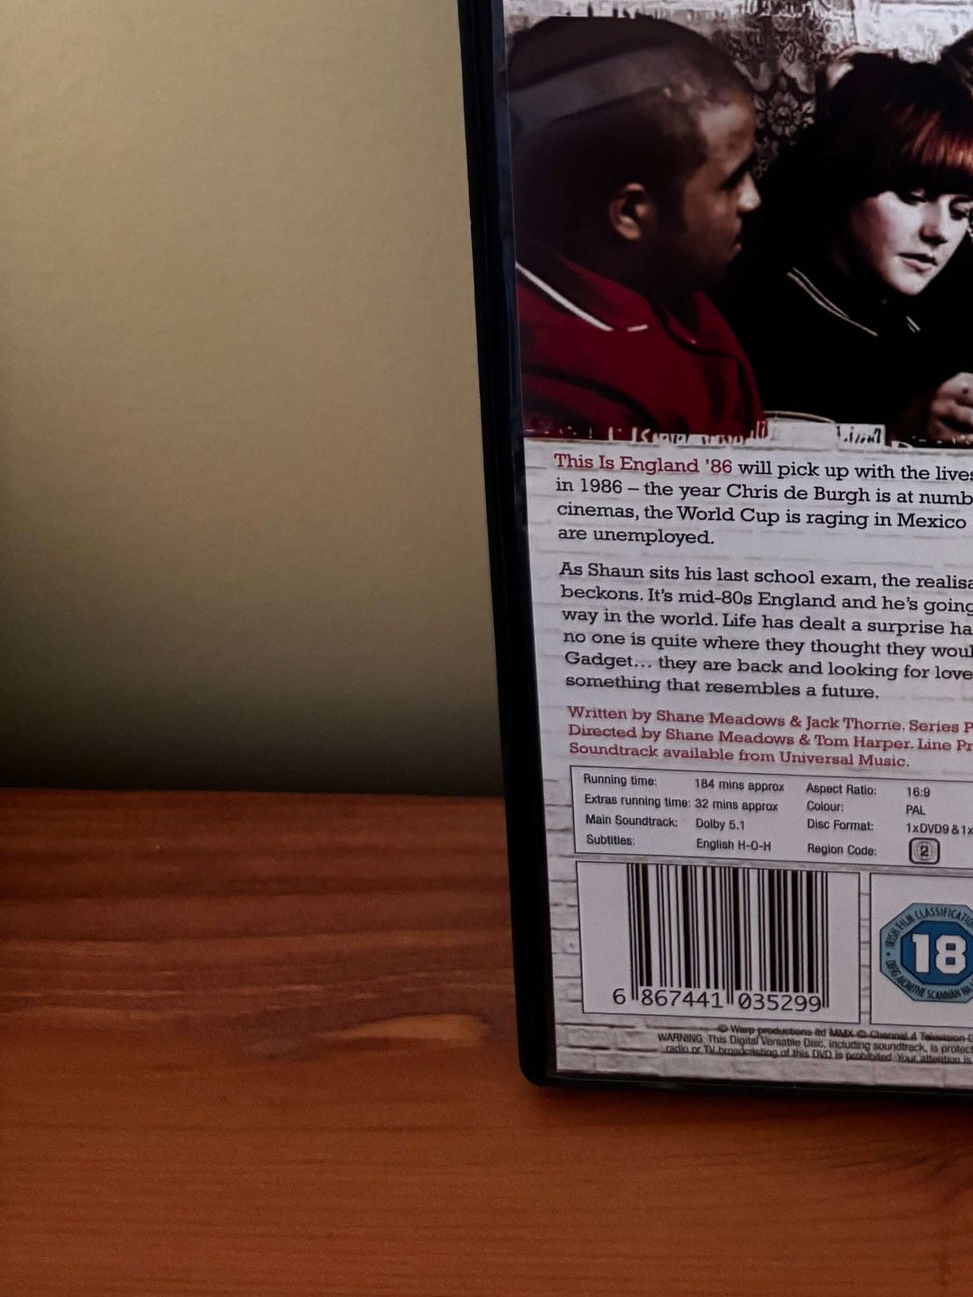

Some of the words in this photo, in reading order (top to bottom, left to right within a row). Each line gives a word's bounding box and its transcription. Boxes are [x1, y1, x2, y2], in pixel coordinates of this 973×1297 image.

[555, 454, 593, 469] This
[600, 455, 614, 470] Is
[620, 456, 699, 475] England
[705, 459, 732, 473] ’86
[738, 461, 772, 475] will
[777, 462, 819, 478] pick
[825, 464, 849, 480] up
[855, 465, 895, 479] with
[901, 466, 930, 480] the
[558, 527, 587, 540] are
[594, 528, 714, 547] unemployed.
[566, 675, 660, 693] something
[667, 678, 700, 692] that
[706, 681, 800, 696] resembles
[806, 685, 816, 697] a
[822, 684, 879, 699] future.
[569, 742, 658, 758] Soundtrack
[664, 746, 734, 761] available
[739, 750, 775, 763] from
[780, 752, 853, 765] Universal
[859, 754, 909, 767] Music.
[584, 774, 627, 786] Running
[631, 775, 657, 786] time:
[695, 779, 714, 789] 184
[719, 780, 744, 790] mins
[748, 783, 784, 795] approx
[806, 783, 842, 795] Aspect
[847, 784, 876, 795] Ratio:
[907, 787, 930, 798] 16:9
[585, 794, 617, 805] Extras
[621, 797, 661, 808] running
[665, 797, 690, 808] time:
[695, 799, 708, 808] 32
[713, 800, 738, 810] mins
[742, 802, 778, 813] approx
[807, 801, 844, 812] Colour:
[906, 805, 926, 815] PAL
[586, 814, 611, 825] Main
[616, 815, 678, 827] Soundtrack:
[696, 819, 725, 831] Dolby
[729, 821, 745, 830] 5.1
[807, 819, 830, 830] Disc
[834, 820, 874, 831] Format:
[907, 823, 949, 834] 1xDVD9
[952, 825, 960, 834] &
[586, 834, 635, 846] Subtitles:
[697, 839, 734, 851] English
[738, 841, 771, 851] H-O-H
[807, 844, 844, 856] Region
[848, 845, 877, 856] Code:
[920, 845, 929, 857] 2
[912, 934, 966, 974] 18
[613, 988, 626, 1005] 6
[642, 989, 724, 1008] 867441
[739, 992, 821, 1013] 035299
[708, 1035, 727, 1044] This
[730, 1035, 758, 1047] Digital
[829, 1040, 871, 1051] including
